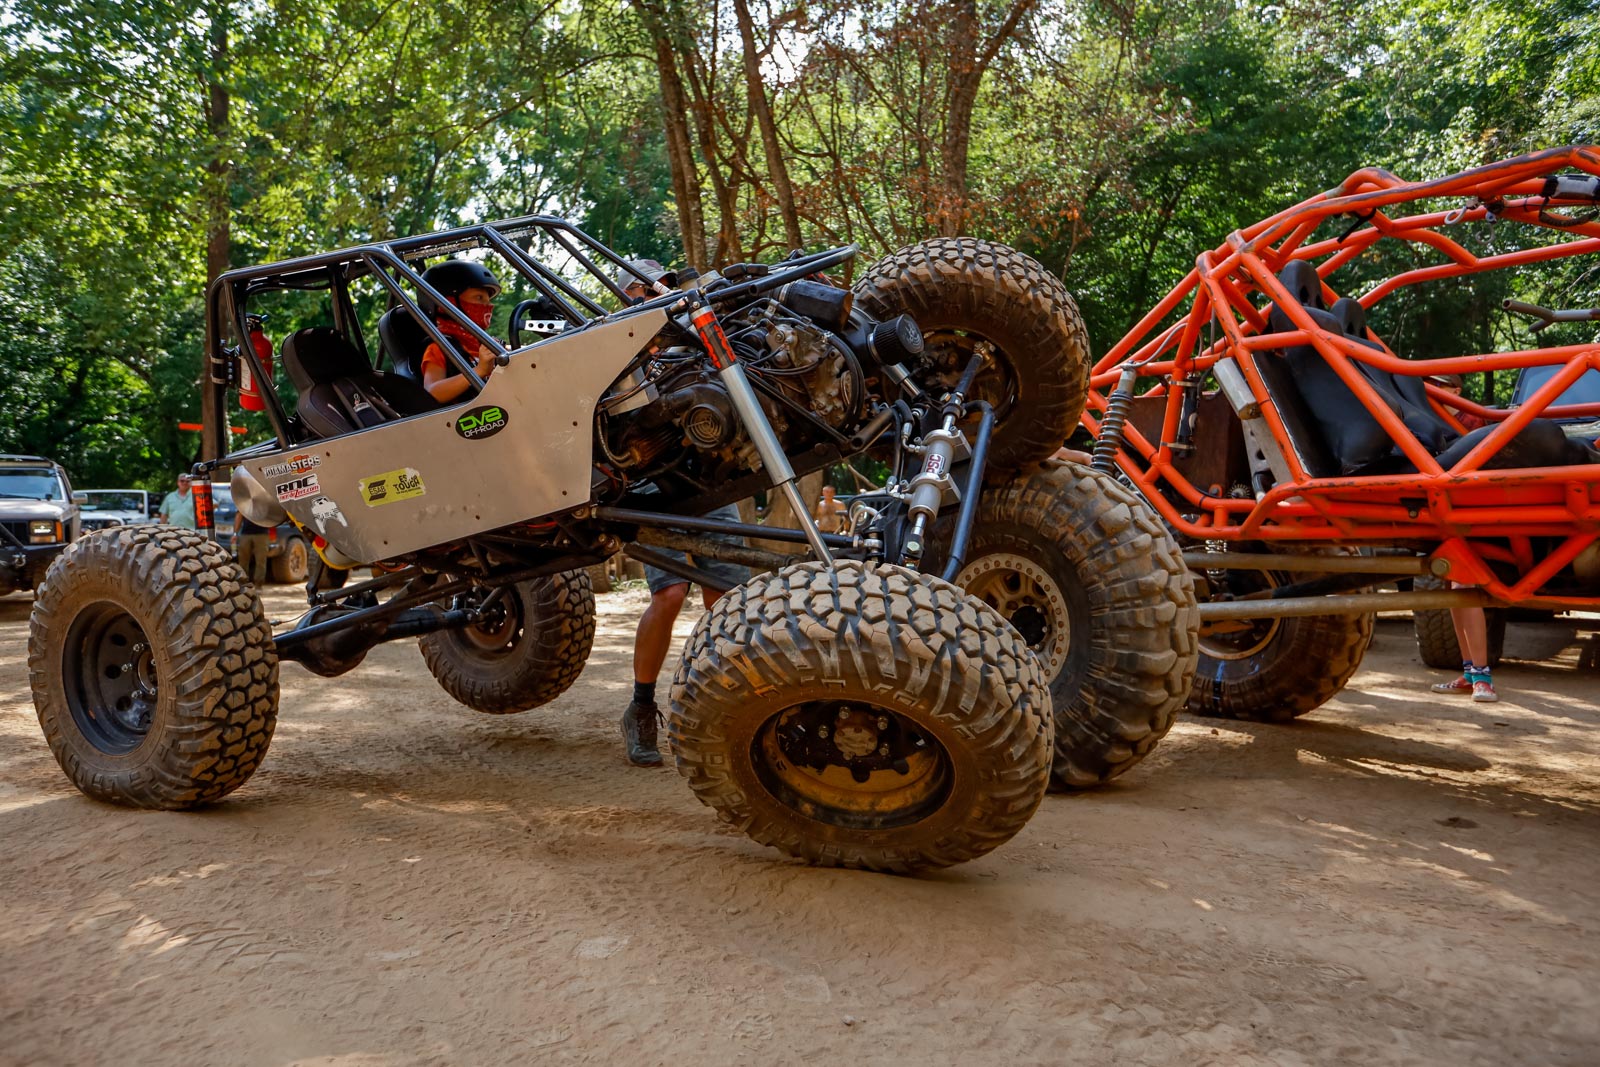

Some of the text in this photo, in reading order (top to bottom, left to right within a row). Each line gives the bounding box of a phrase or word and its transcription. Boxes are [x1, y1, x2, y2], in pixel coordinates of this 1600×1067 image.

[458, 407, 502, 431] DV8
[926, 454, 941, 473] PSC
[368, 485, 386, 495] ESAB
[393, 478, 420, 491] TOUGH
